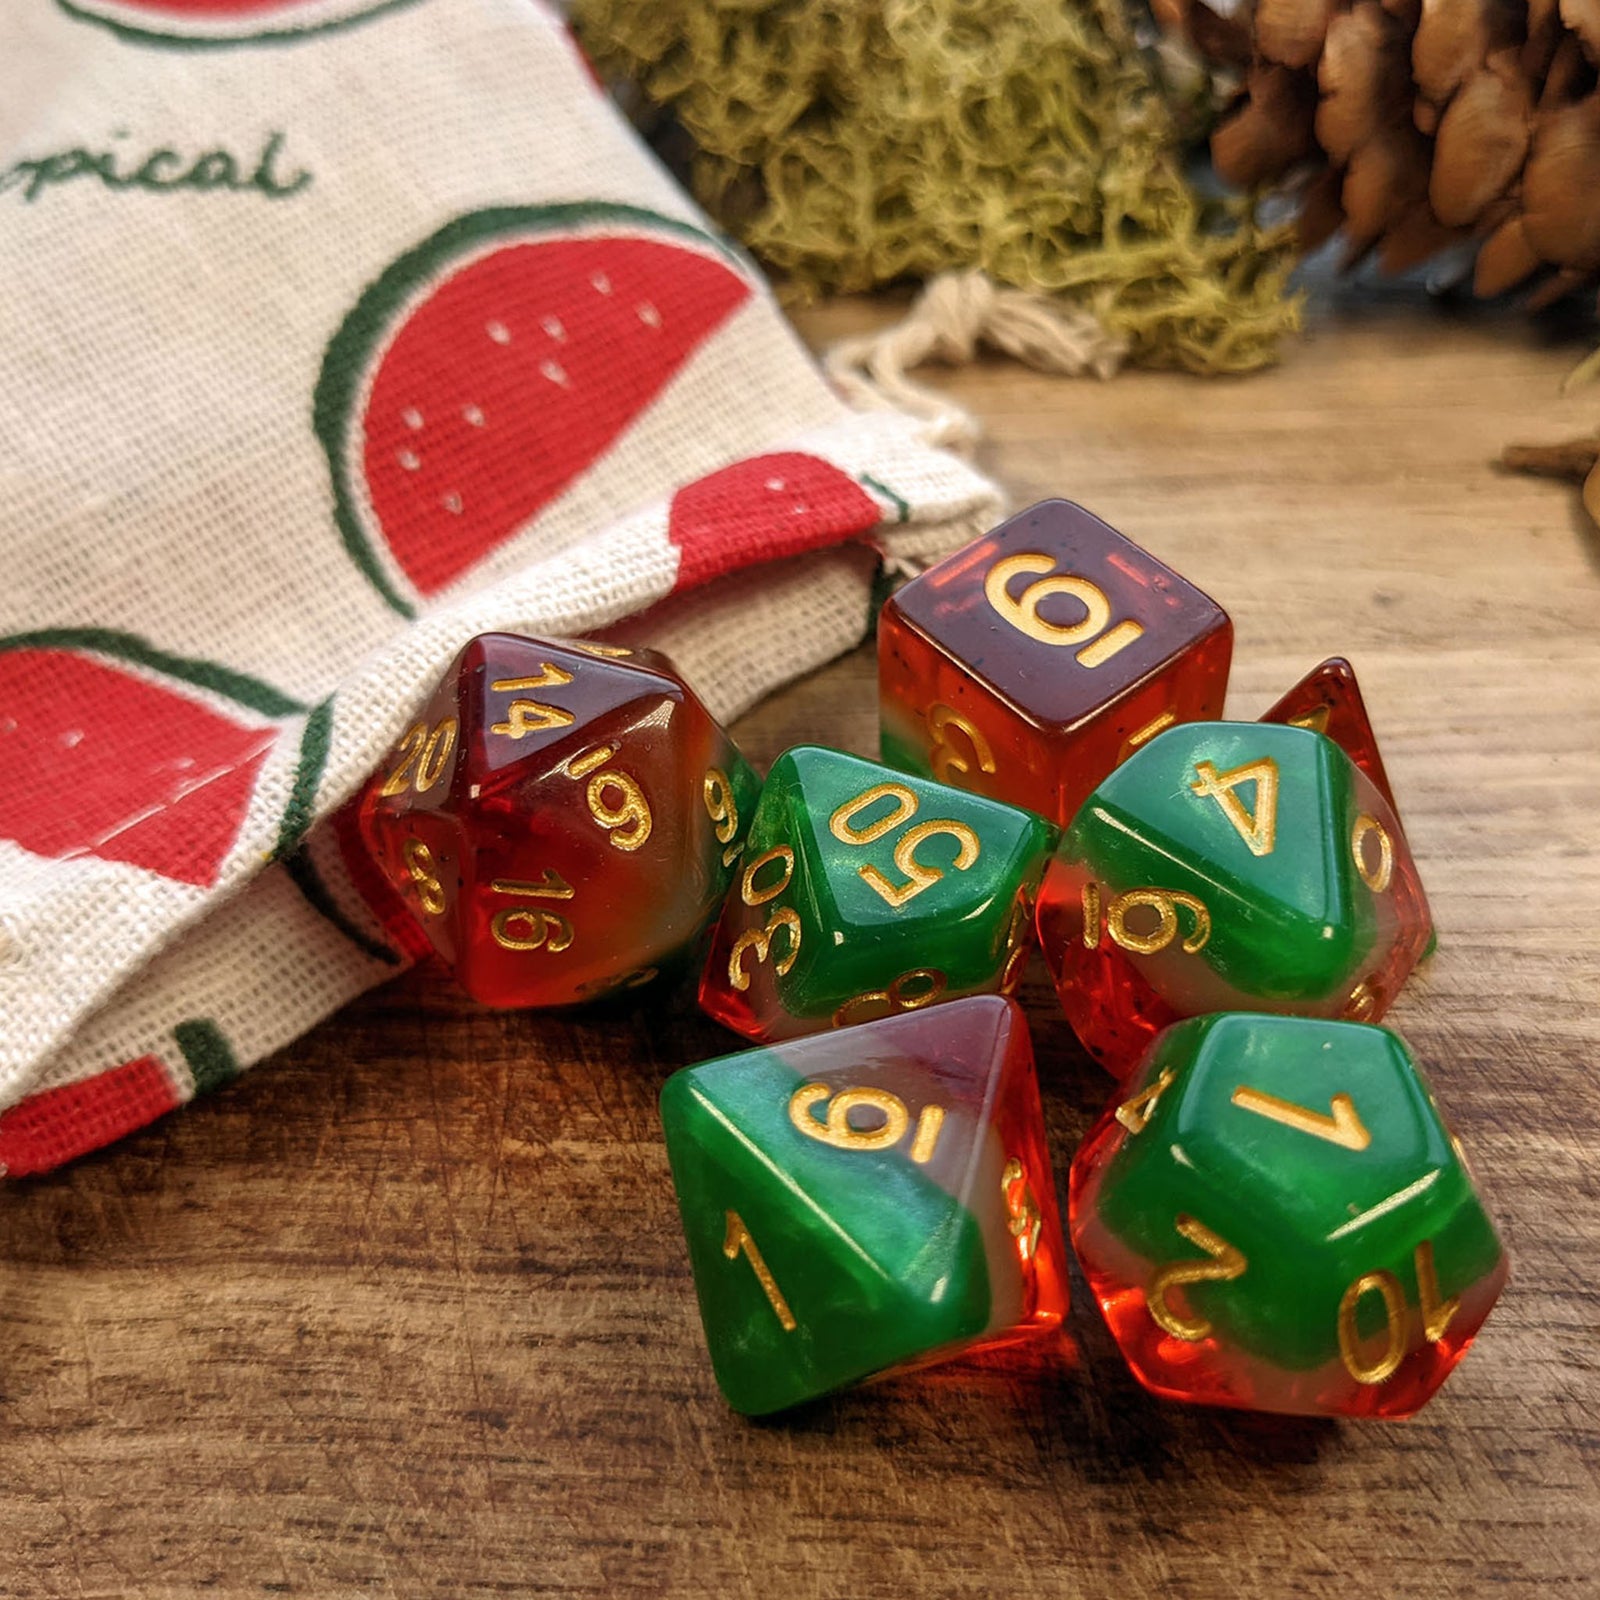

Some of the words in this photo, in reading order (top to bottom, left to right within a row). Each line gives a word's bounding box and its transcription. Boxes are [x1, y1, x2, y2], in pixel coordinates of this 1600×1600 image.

[491, 662, 577, 739] 14
[381, 716, 458, 797] 20
[829, 782, 981, 907] 50
[1190, 755, 1279, 858] 4
[404, 838, 446, 914] 8
[1351, 814, 1394, 893] 0
[490, 868, 576, 953] 16
[728, 845, 802, 991] 30
[1114, 1066, 1177, 1135] 4
[1231, 1085, 1372, 1152] 1
[723, 1208, 797, 1332] 1
[1146, 1212, 1248, 1342] 2
[1339, 1239, 1461, 1384] 10
